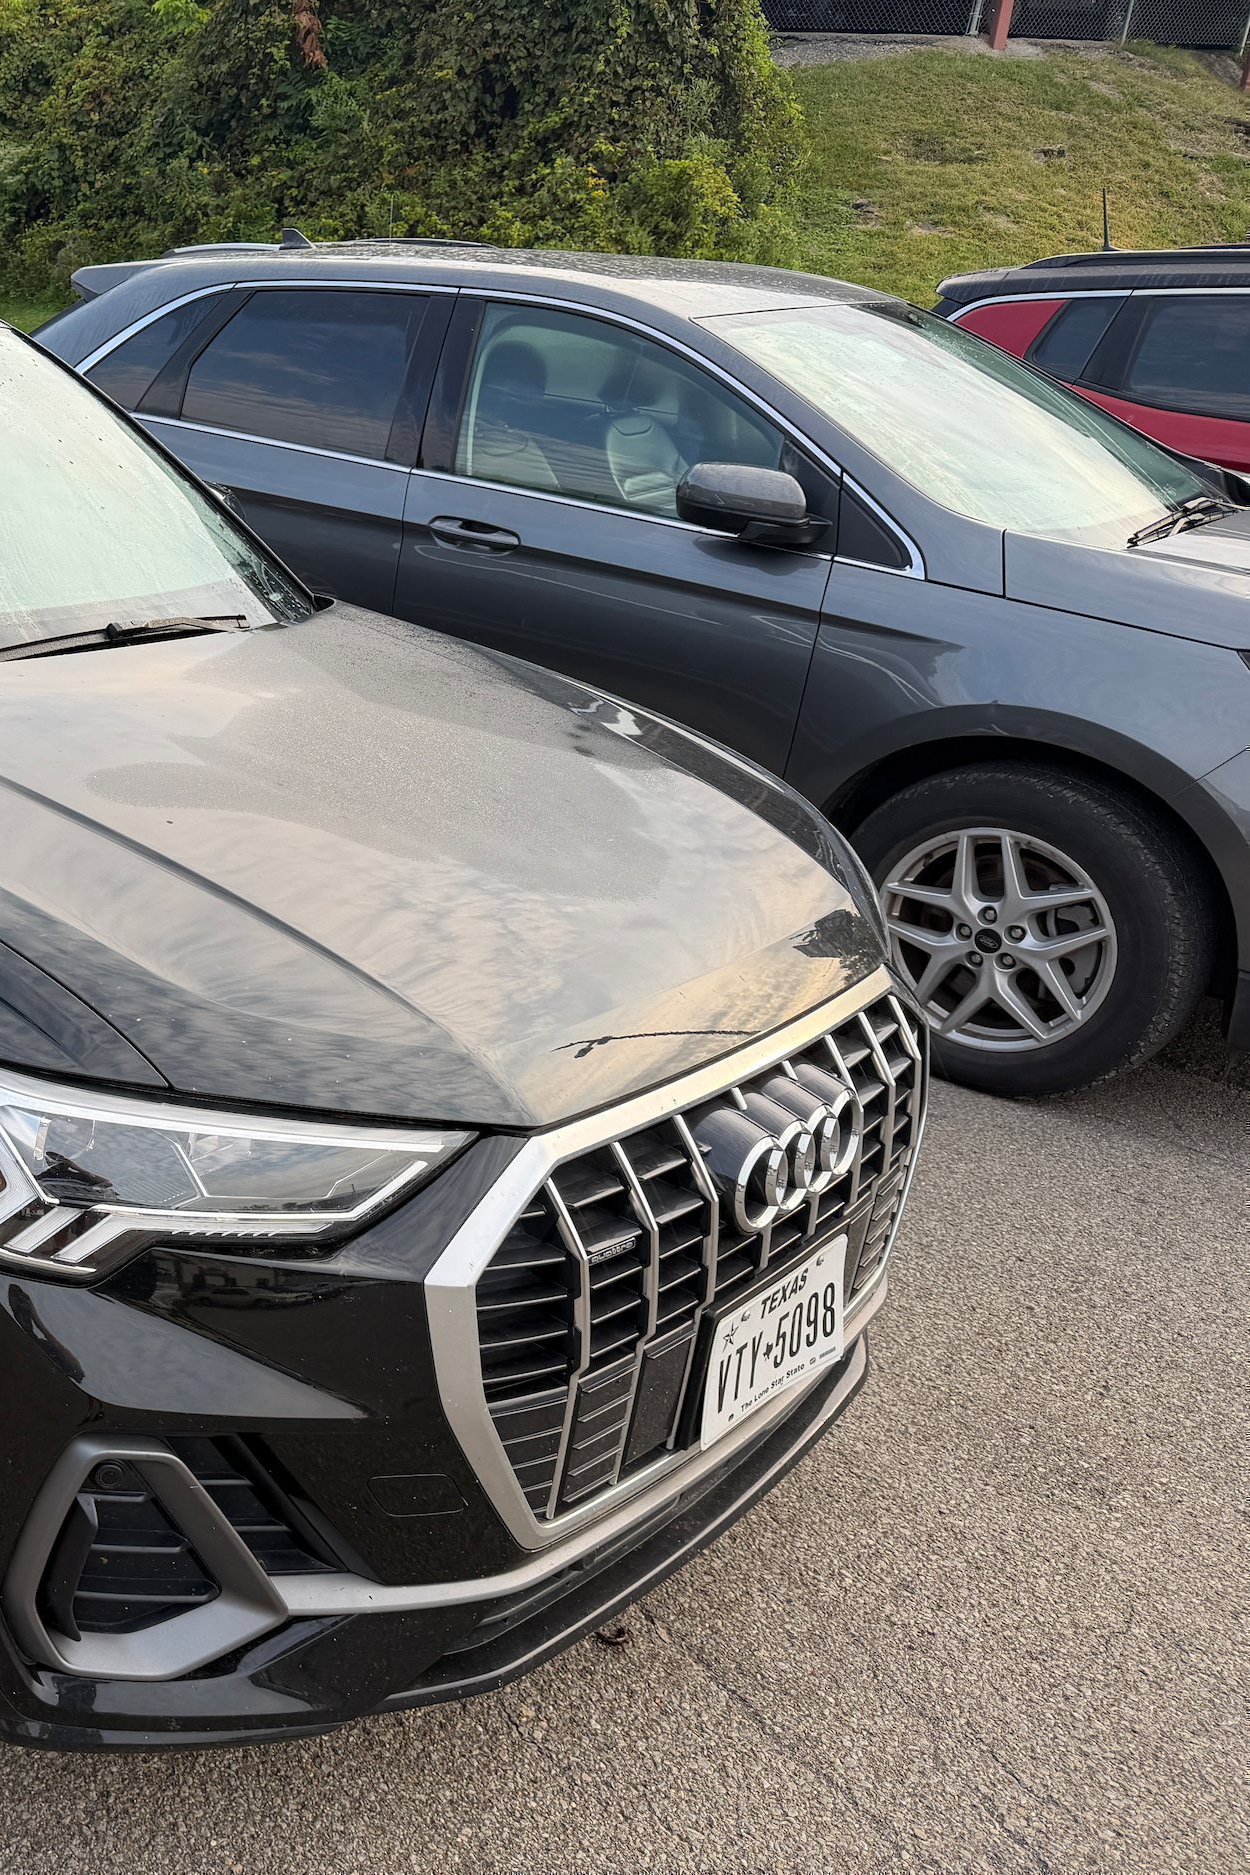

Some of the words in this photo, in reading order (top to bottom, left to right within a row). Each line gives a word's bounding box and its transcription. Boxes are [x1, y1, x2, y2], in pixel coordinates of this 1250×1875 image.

[591, 1241, 634, 1264] quattro
[761, 1267, 809, 1320] TEXAS
[741, 1398, 753, 1412] The
[754, 1386, 770, 1402] Lone
[771, 1375, 785, 1390] Star
[786, 1363, 805, 1379] State
